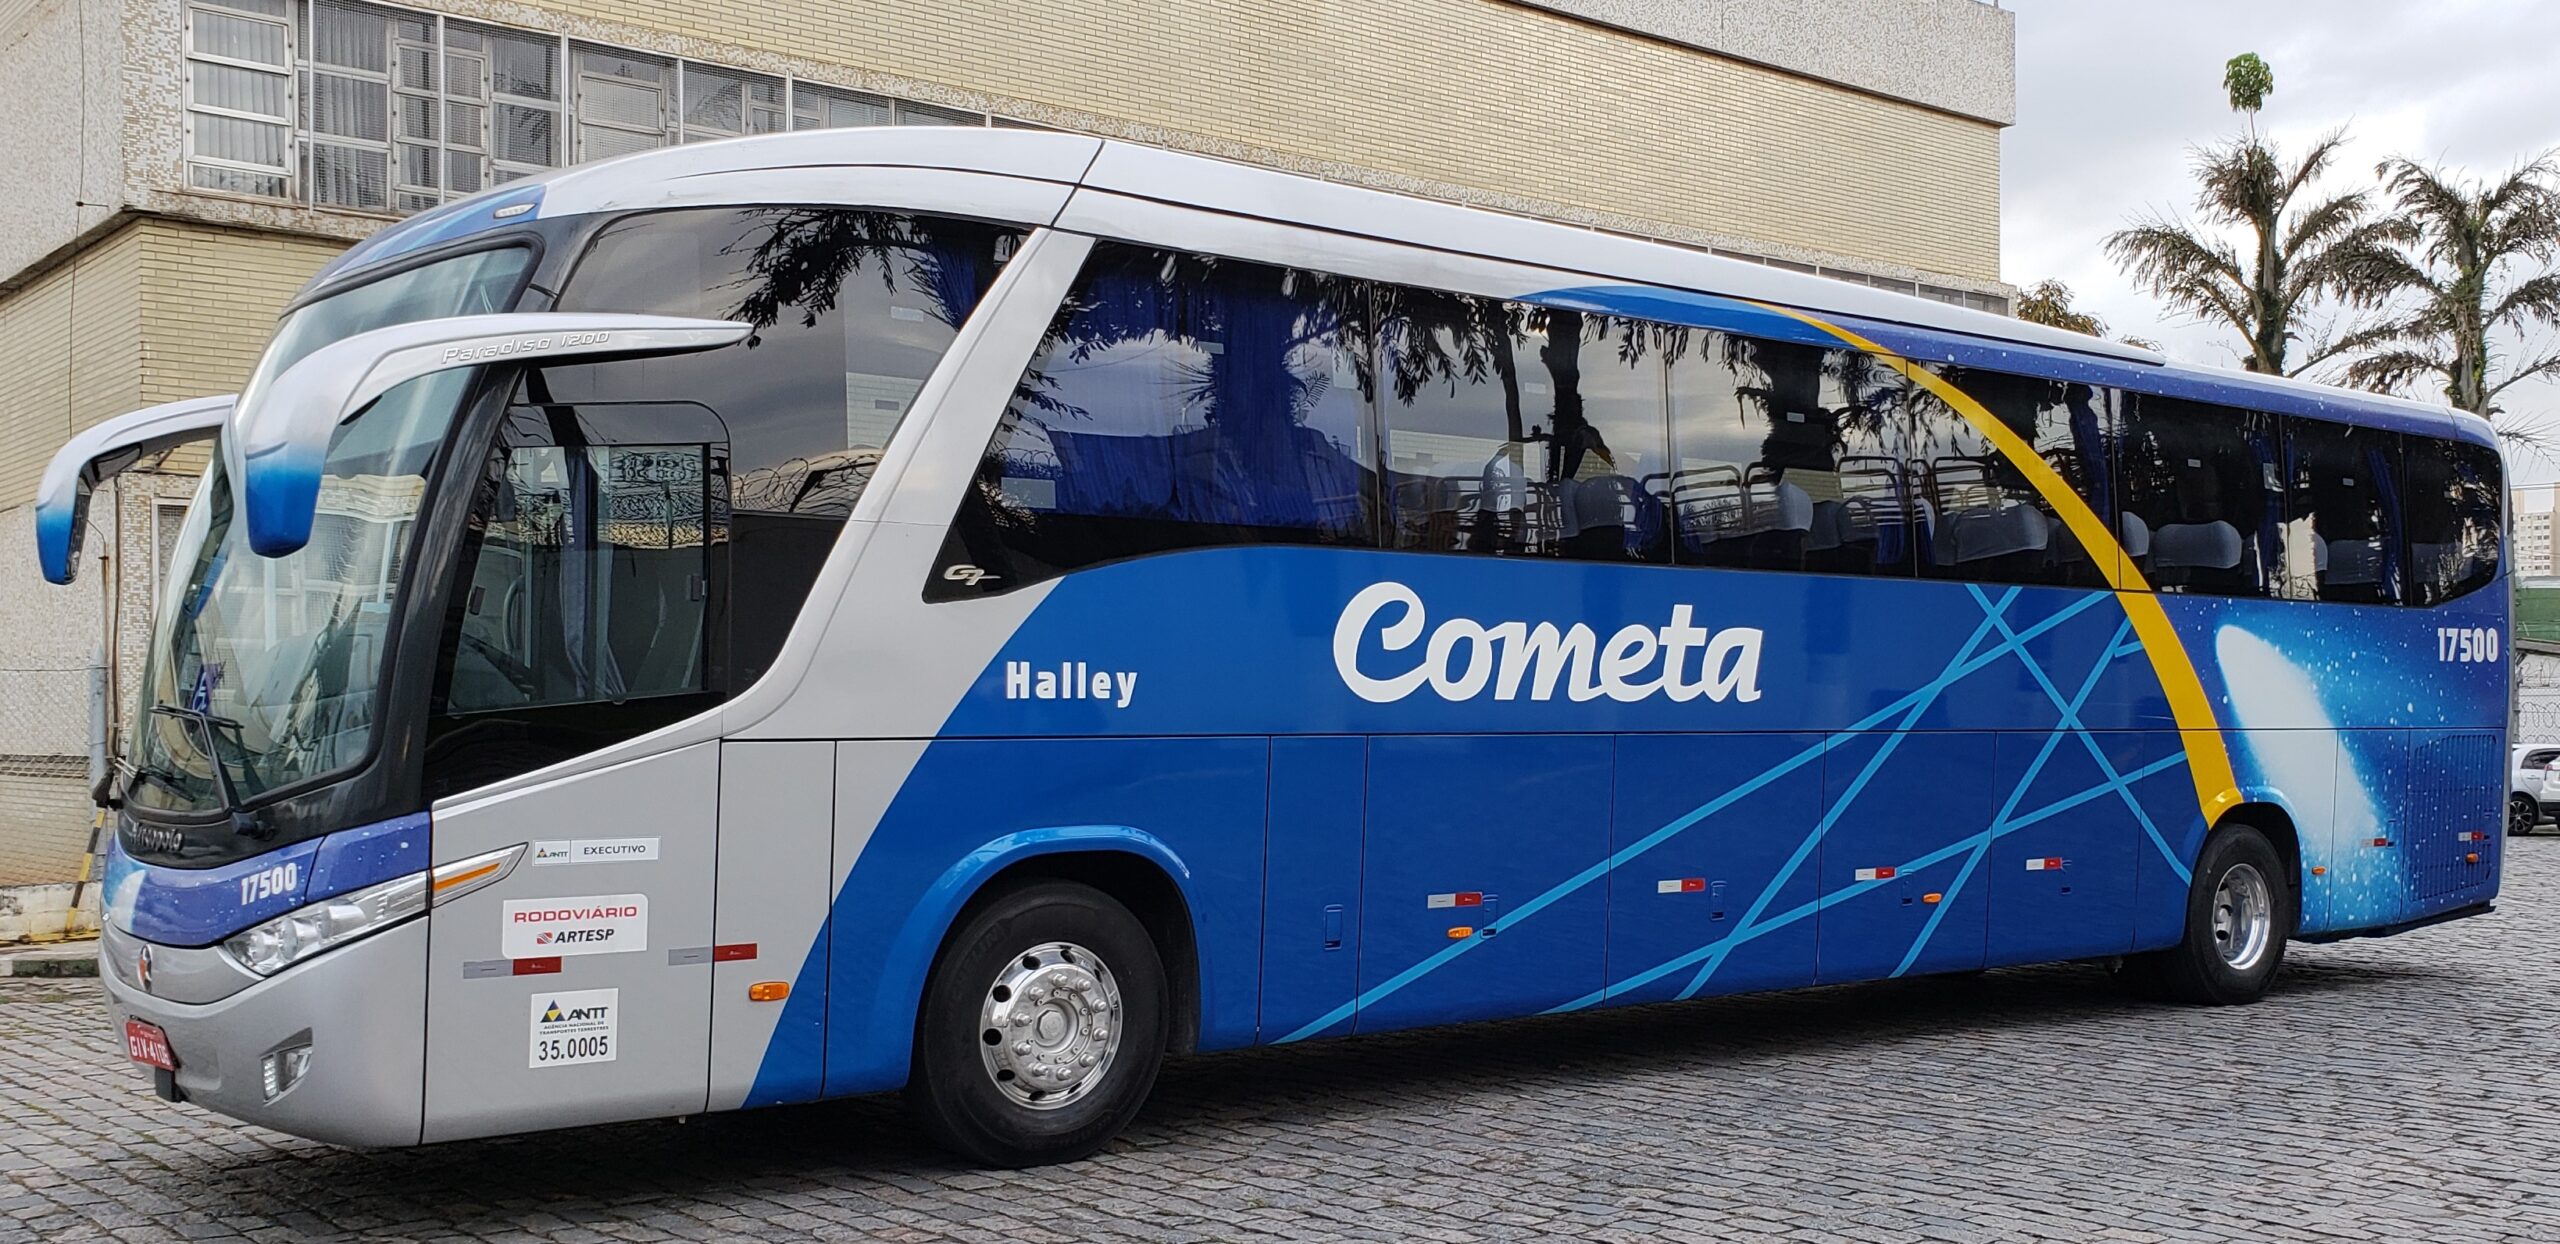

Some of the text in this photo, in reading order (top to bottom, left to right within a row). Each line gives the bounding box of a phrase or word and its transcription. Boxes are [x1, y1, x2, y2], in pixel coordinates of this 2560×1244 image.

[441, 331, 610, 364] Paradiso 1200
[1333, 581, 1763, 702] Cometa
[2437, 627, 2499, 663] 17500
[1007, 661, 1138, 708] Halley
[583, 845, 647, 855] EXECUTIVO
[241, 862, 298, 906] 17500
[514, 905, 638, 923] RODOVIÁRIO
[554, 928, 615, 944] ARTESP
[567, 1006, 609, 1021] ANTT
[540, 1025, 609, 1036] TRANSPORTES TERRESTRES
[538, 1035, 608, 1061] 35.0005
